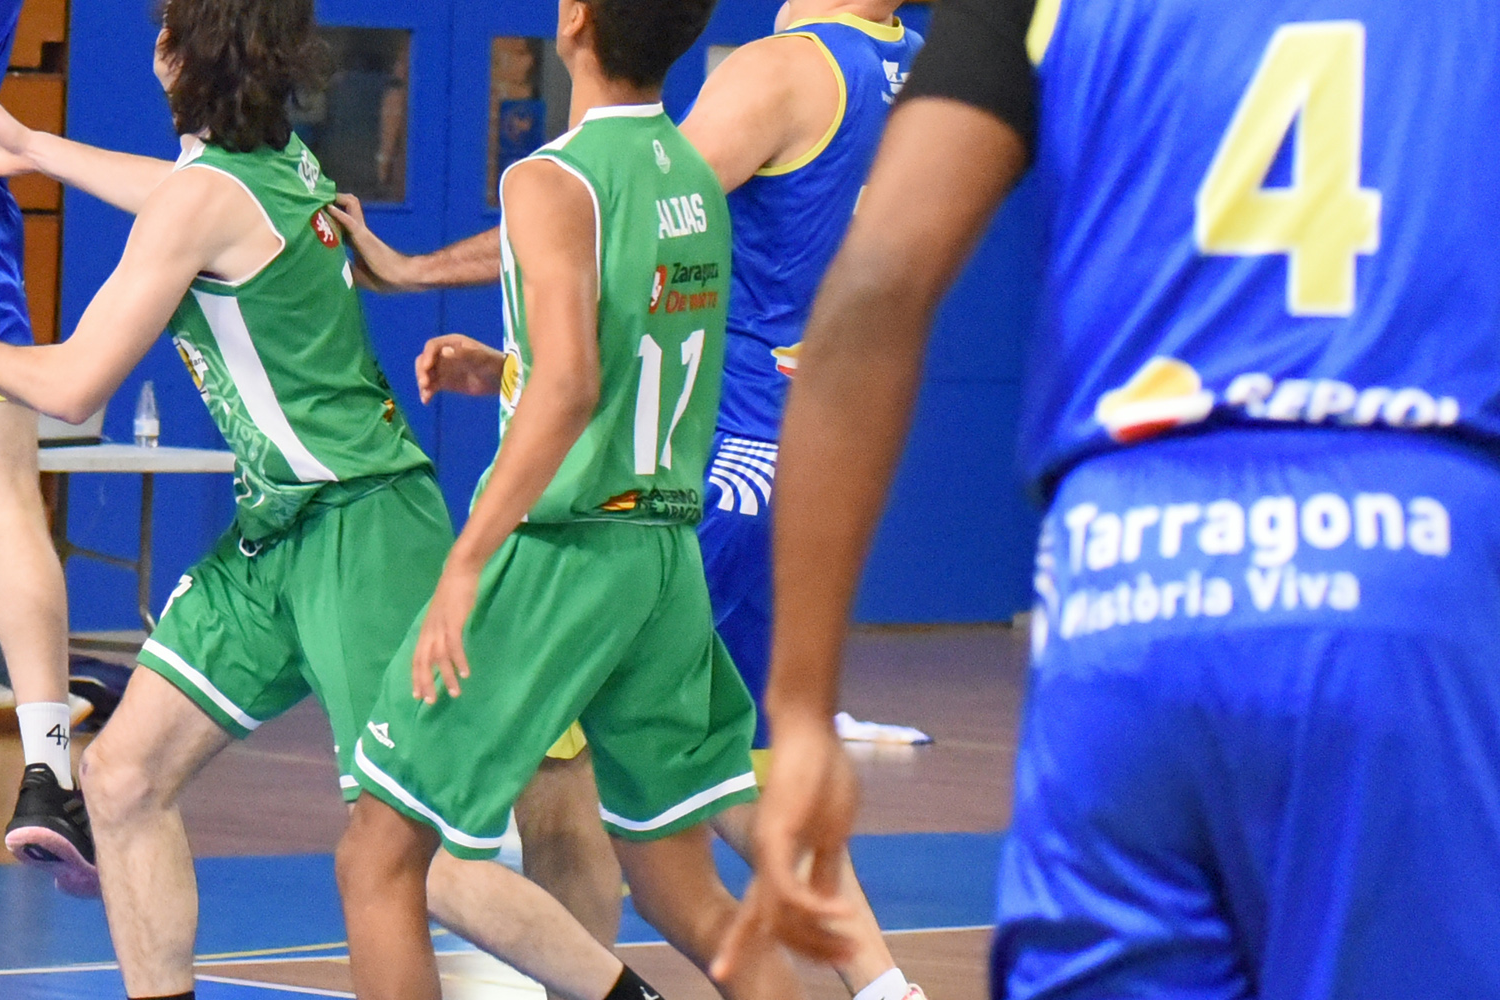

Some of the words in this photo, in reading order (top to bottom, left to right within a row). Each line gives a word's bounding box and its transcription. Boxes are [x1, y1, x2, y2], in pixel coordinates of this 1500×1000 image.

[1195, 18, 1383, 318] 4
[1063, 492, 1452, 567] Tarragona
[1245, 565, 1361, 612] Viva
